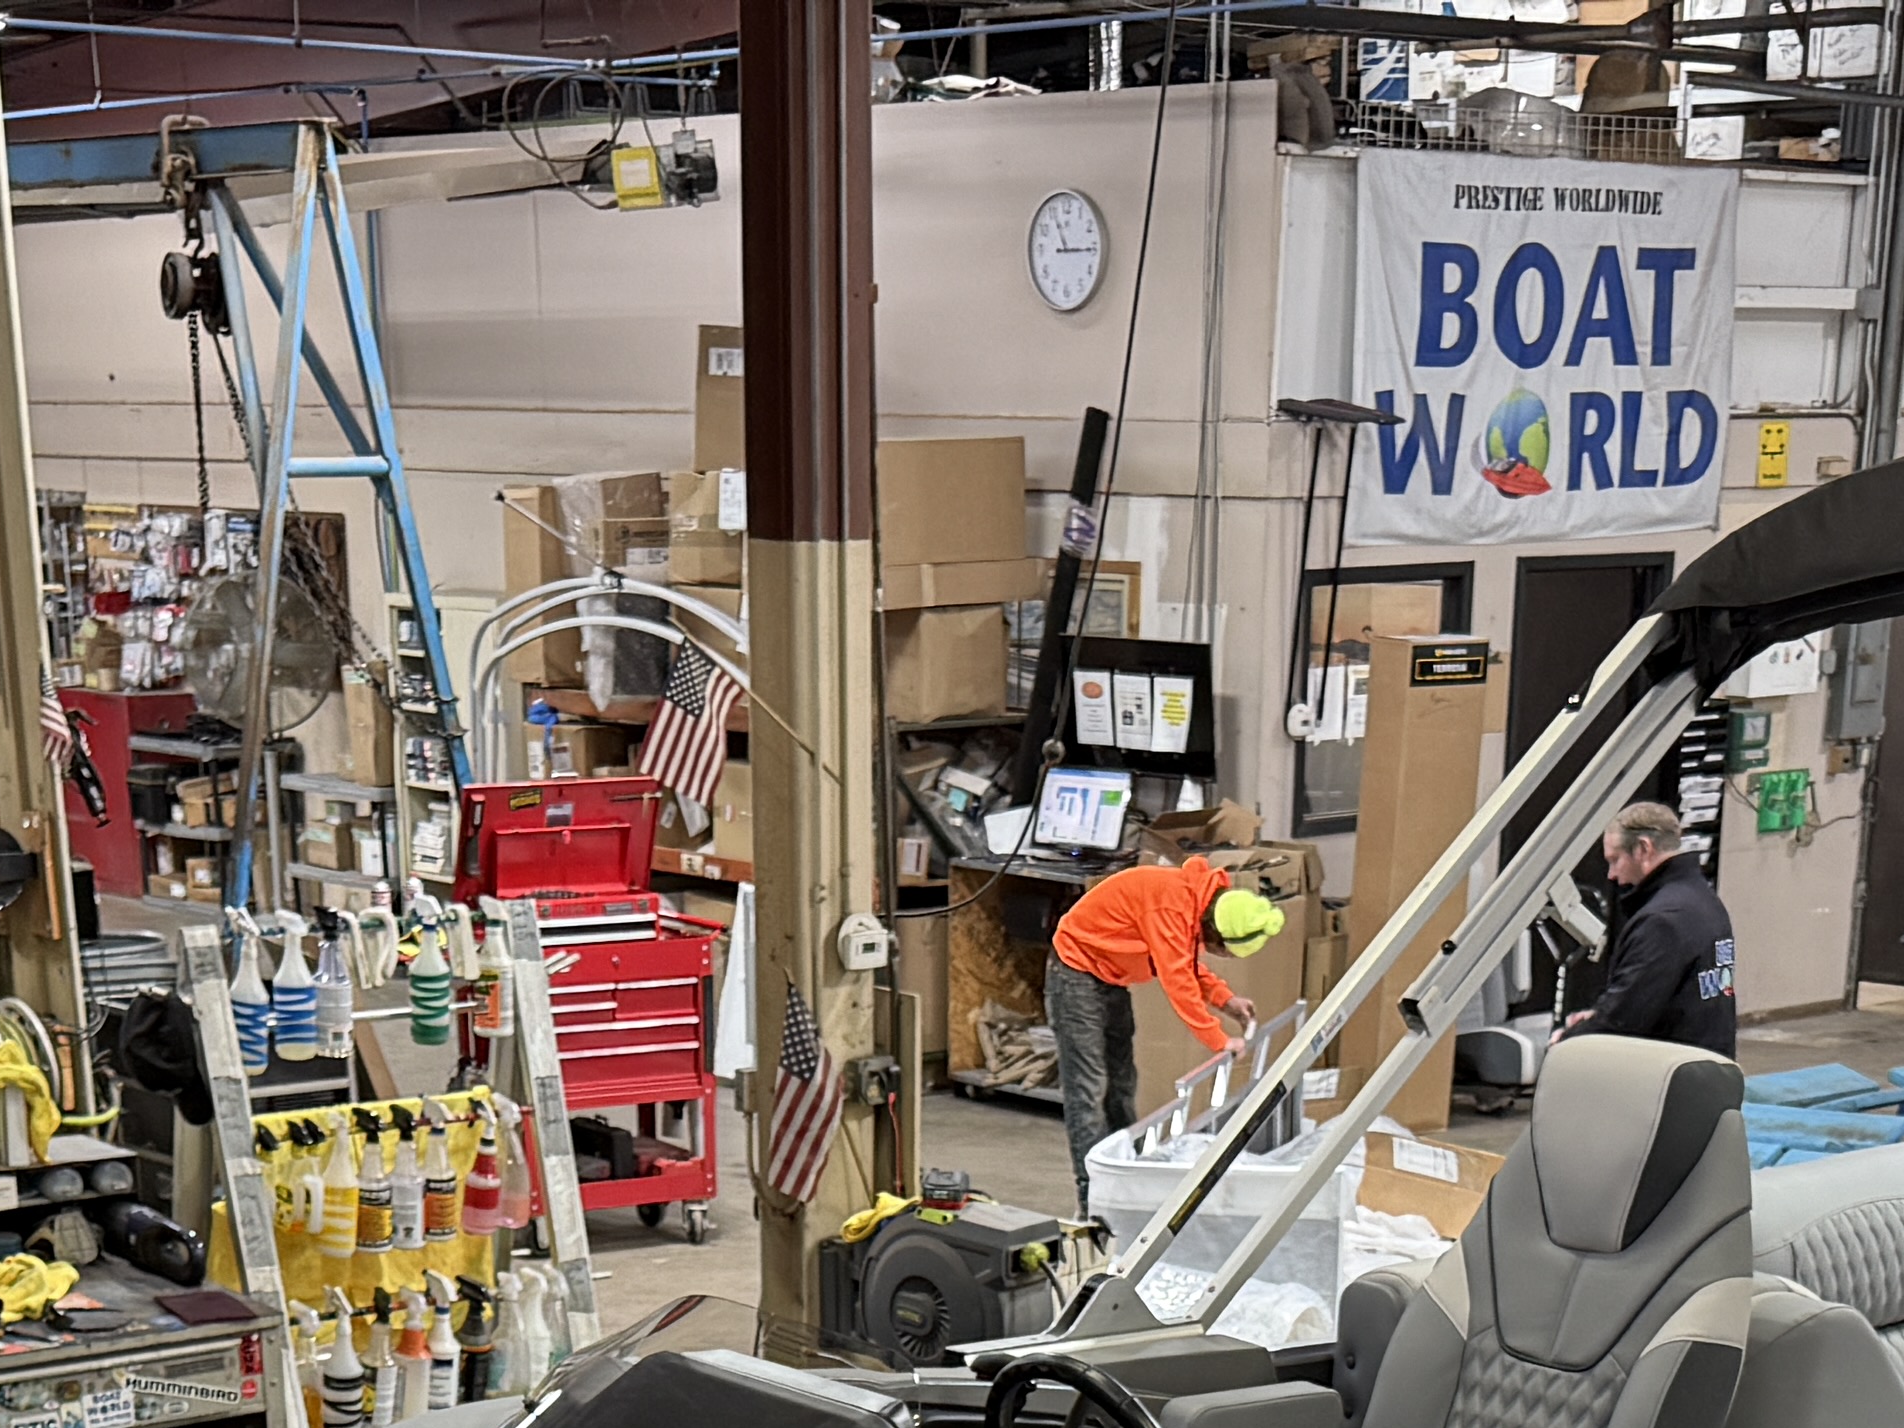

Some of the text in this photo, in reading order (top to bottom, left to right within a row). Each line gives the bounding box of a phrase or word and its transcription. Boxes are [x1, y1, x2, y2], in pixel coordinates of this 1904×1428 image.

[1453, 184, 1663, 215] PRESTIGE WORLDWIDE
[1414, 241, 1696, 369] BOAT
[125, 1377, 238, 1402] HUMMINBIRD
